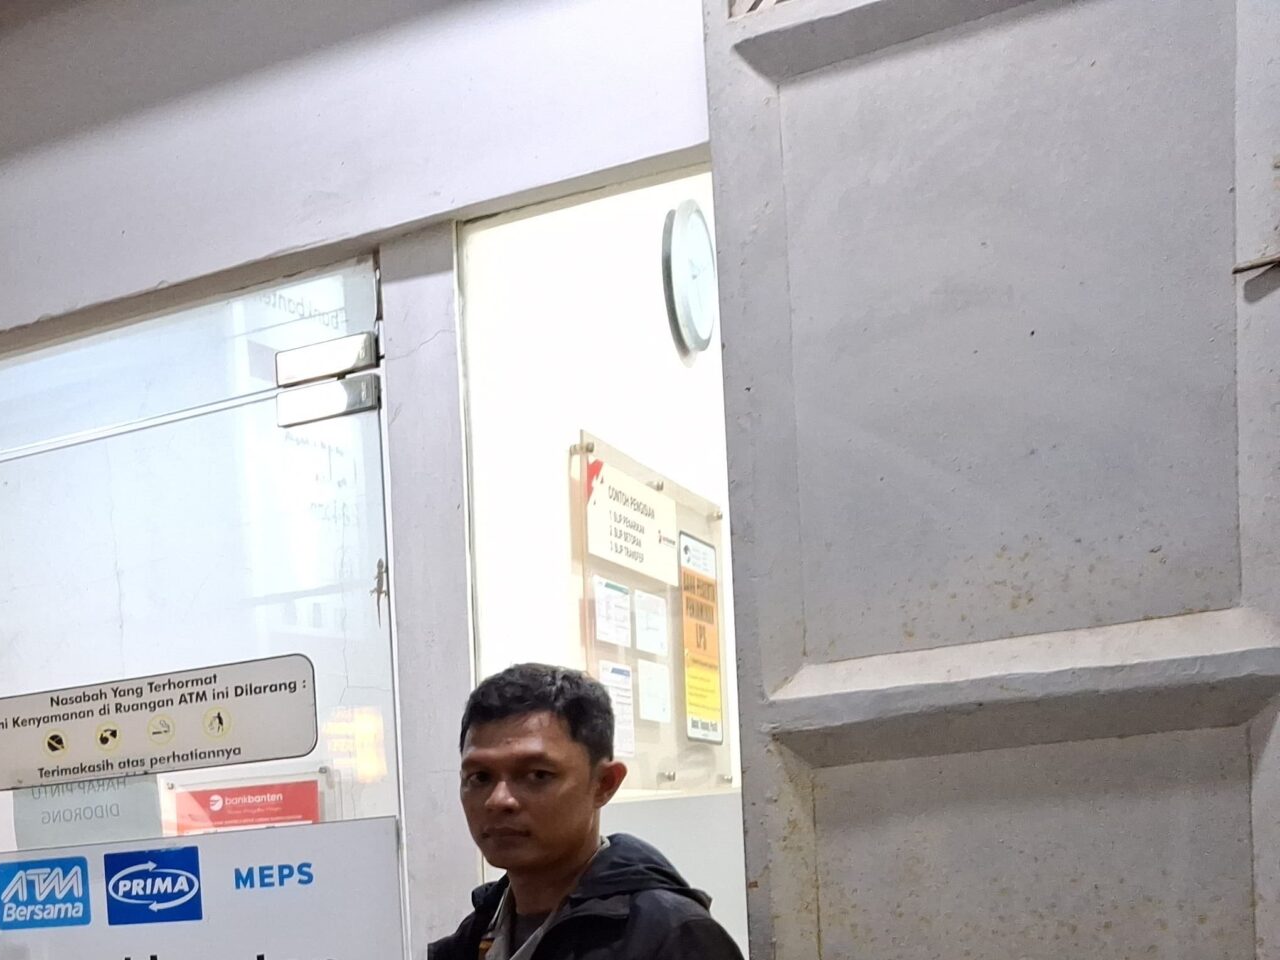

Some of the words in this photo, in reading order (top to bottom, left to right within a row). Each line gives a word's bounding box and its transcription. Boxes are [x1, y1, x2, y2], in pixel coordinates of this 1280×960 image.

[50, 688, 107, 708] Nasabah
[111, 685, 144, 698] Yang
[147, 674, 218, 694] Terhormat
[12, 709, 94, 732] Kenyamanan
[99, 705, 110, 716] di
[115, 698, 174, 714] Ruangan
[178, 691, 208, 706] ATM
[212, 687, 229, 700] ini
[234, 680, 297, 698] Dilarang
[38, 759, 114, 778] Terimakasih
[118, 757, 146, 769] atas
[150, 747, 242, 768] perhatiannya
[224, 792, 284, 806] bankbanten
[1, 865, 83, 902] ATM
[118, 875, 190, 896] PRIMA
[234, 862, 314, 889] MEPS
[2, 902, 83, 923] Bersama
